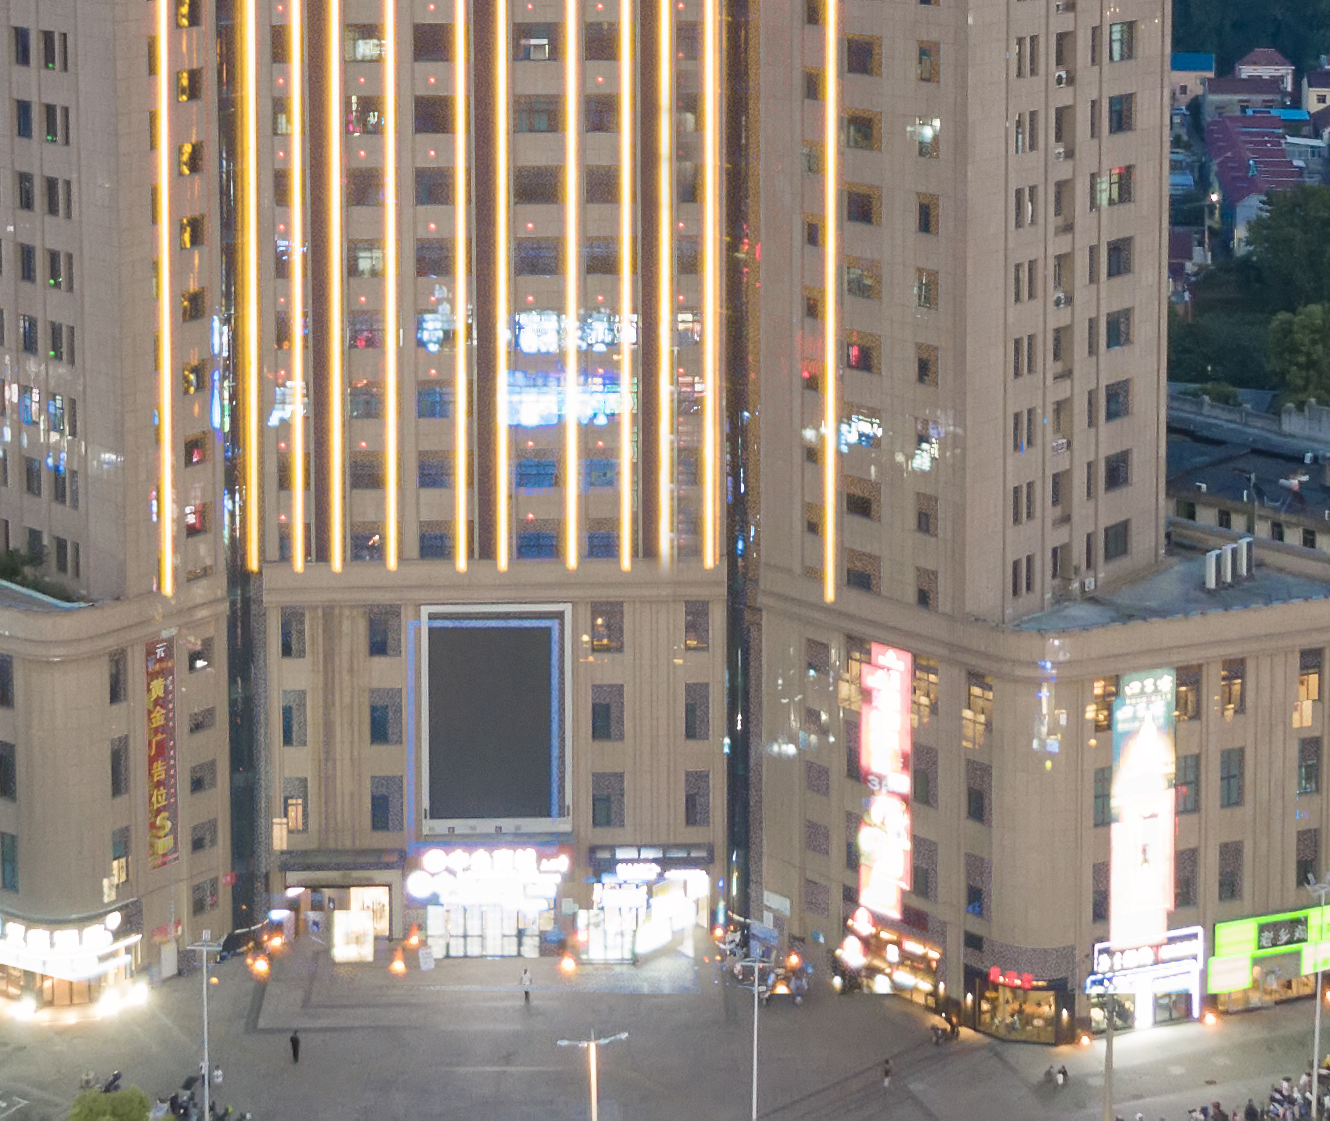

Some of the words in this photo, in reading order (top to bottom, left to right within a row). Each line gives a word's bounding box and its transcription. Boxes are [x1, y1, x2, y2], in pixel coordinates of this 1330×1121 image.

[149, 677, 168, 811] 黄金广告位
